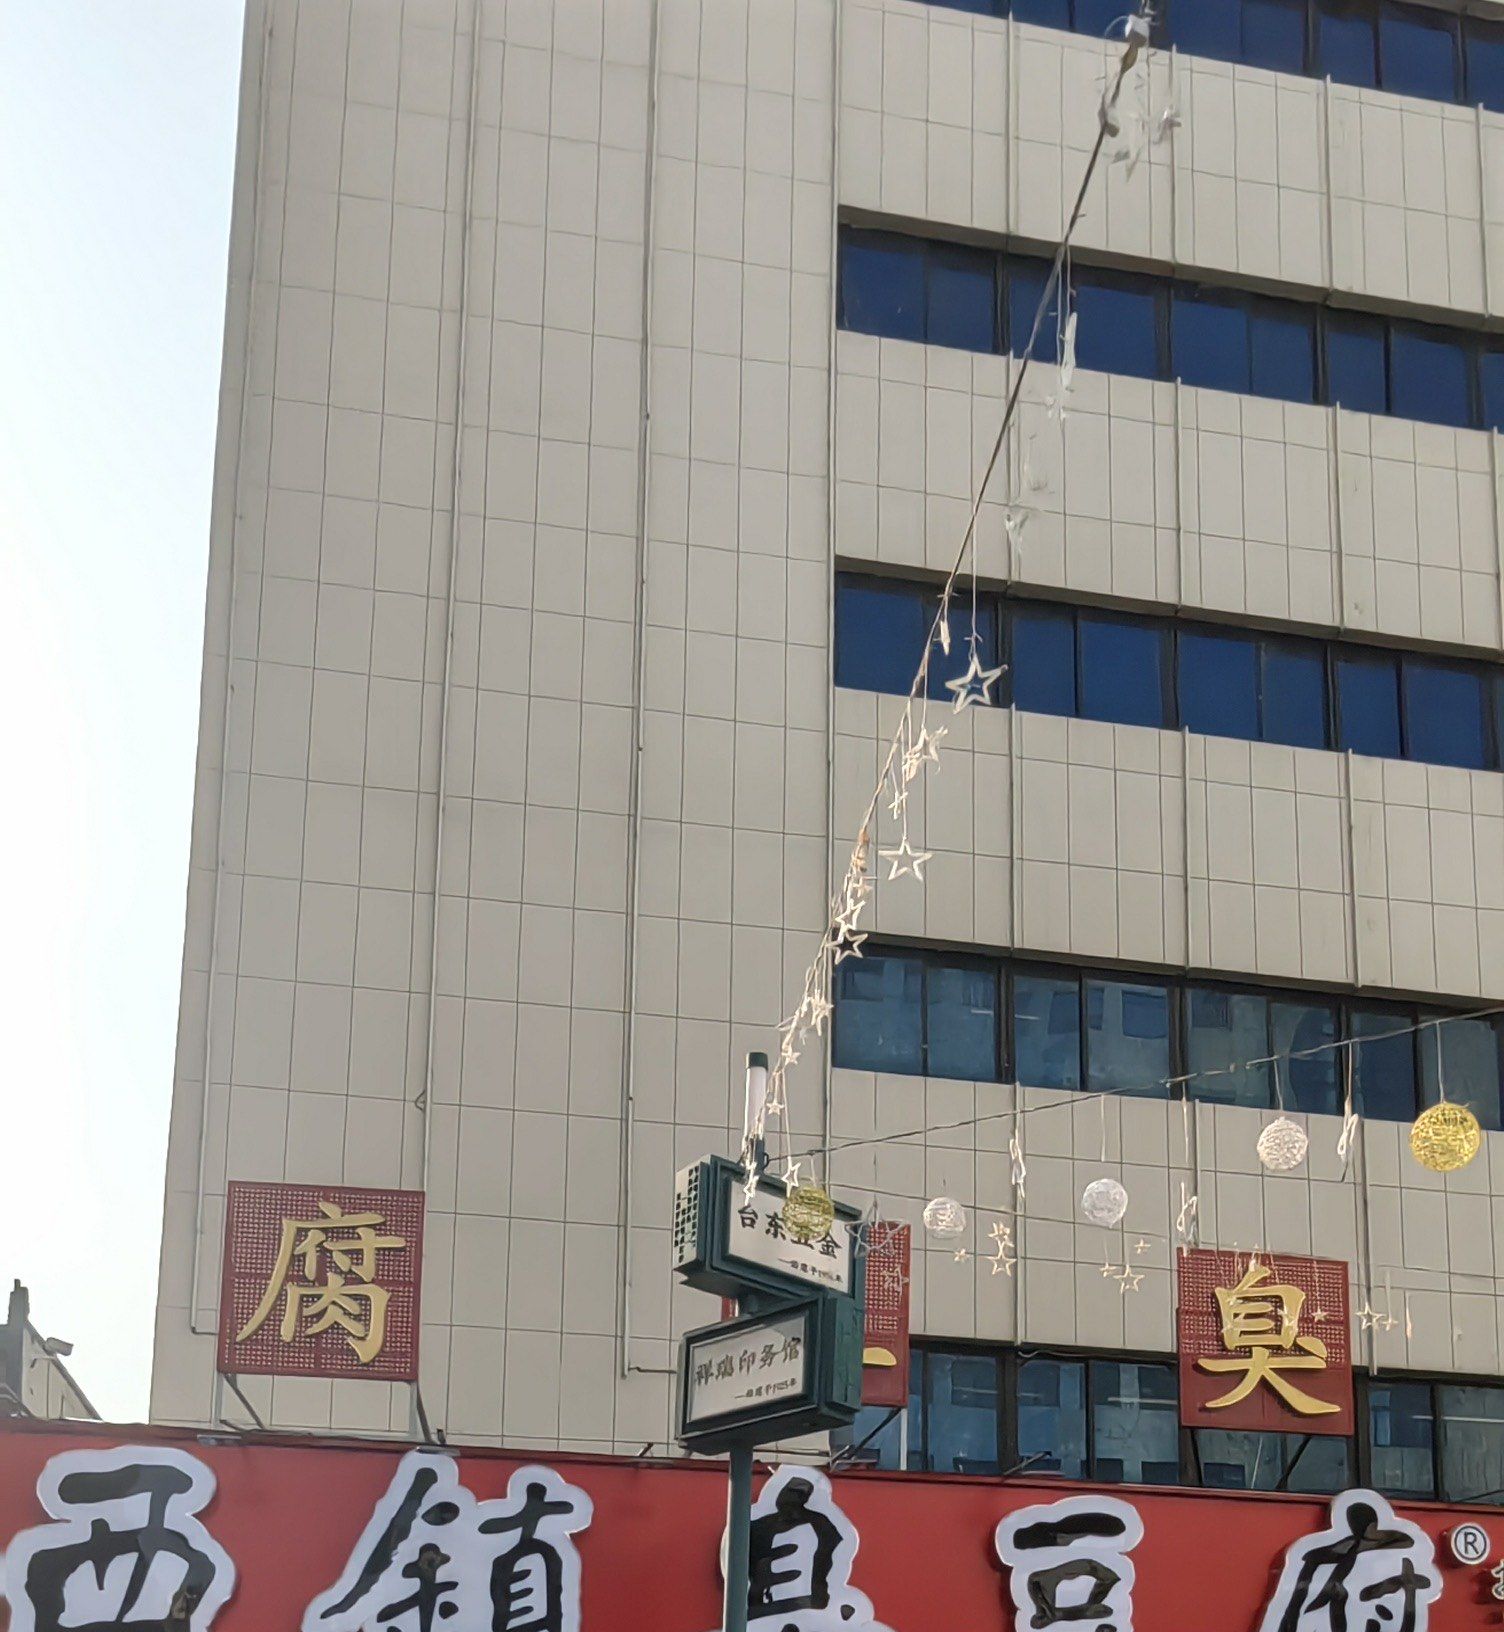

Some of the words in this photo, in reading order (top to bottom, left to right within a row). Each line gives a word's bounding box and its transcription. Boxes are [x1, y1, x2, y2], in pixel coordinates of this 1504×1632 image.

[235, 1200, 407, 1364] 腐
[738, 1204, 841, 1260] 台东金
[1197, 1263, 1342, 1415] 臭
